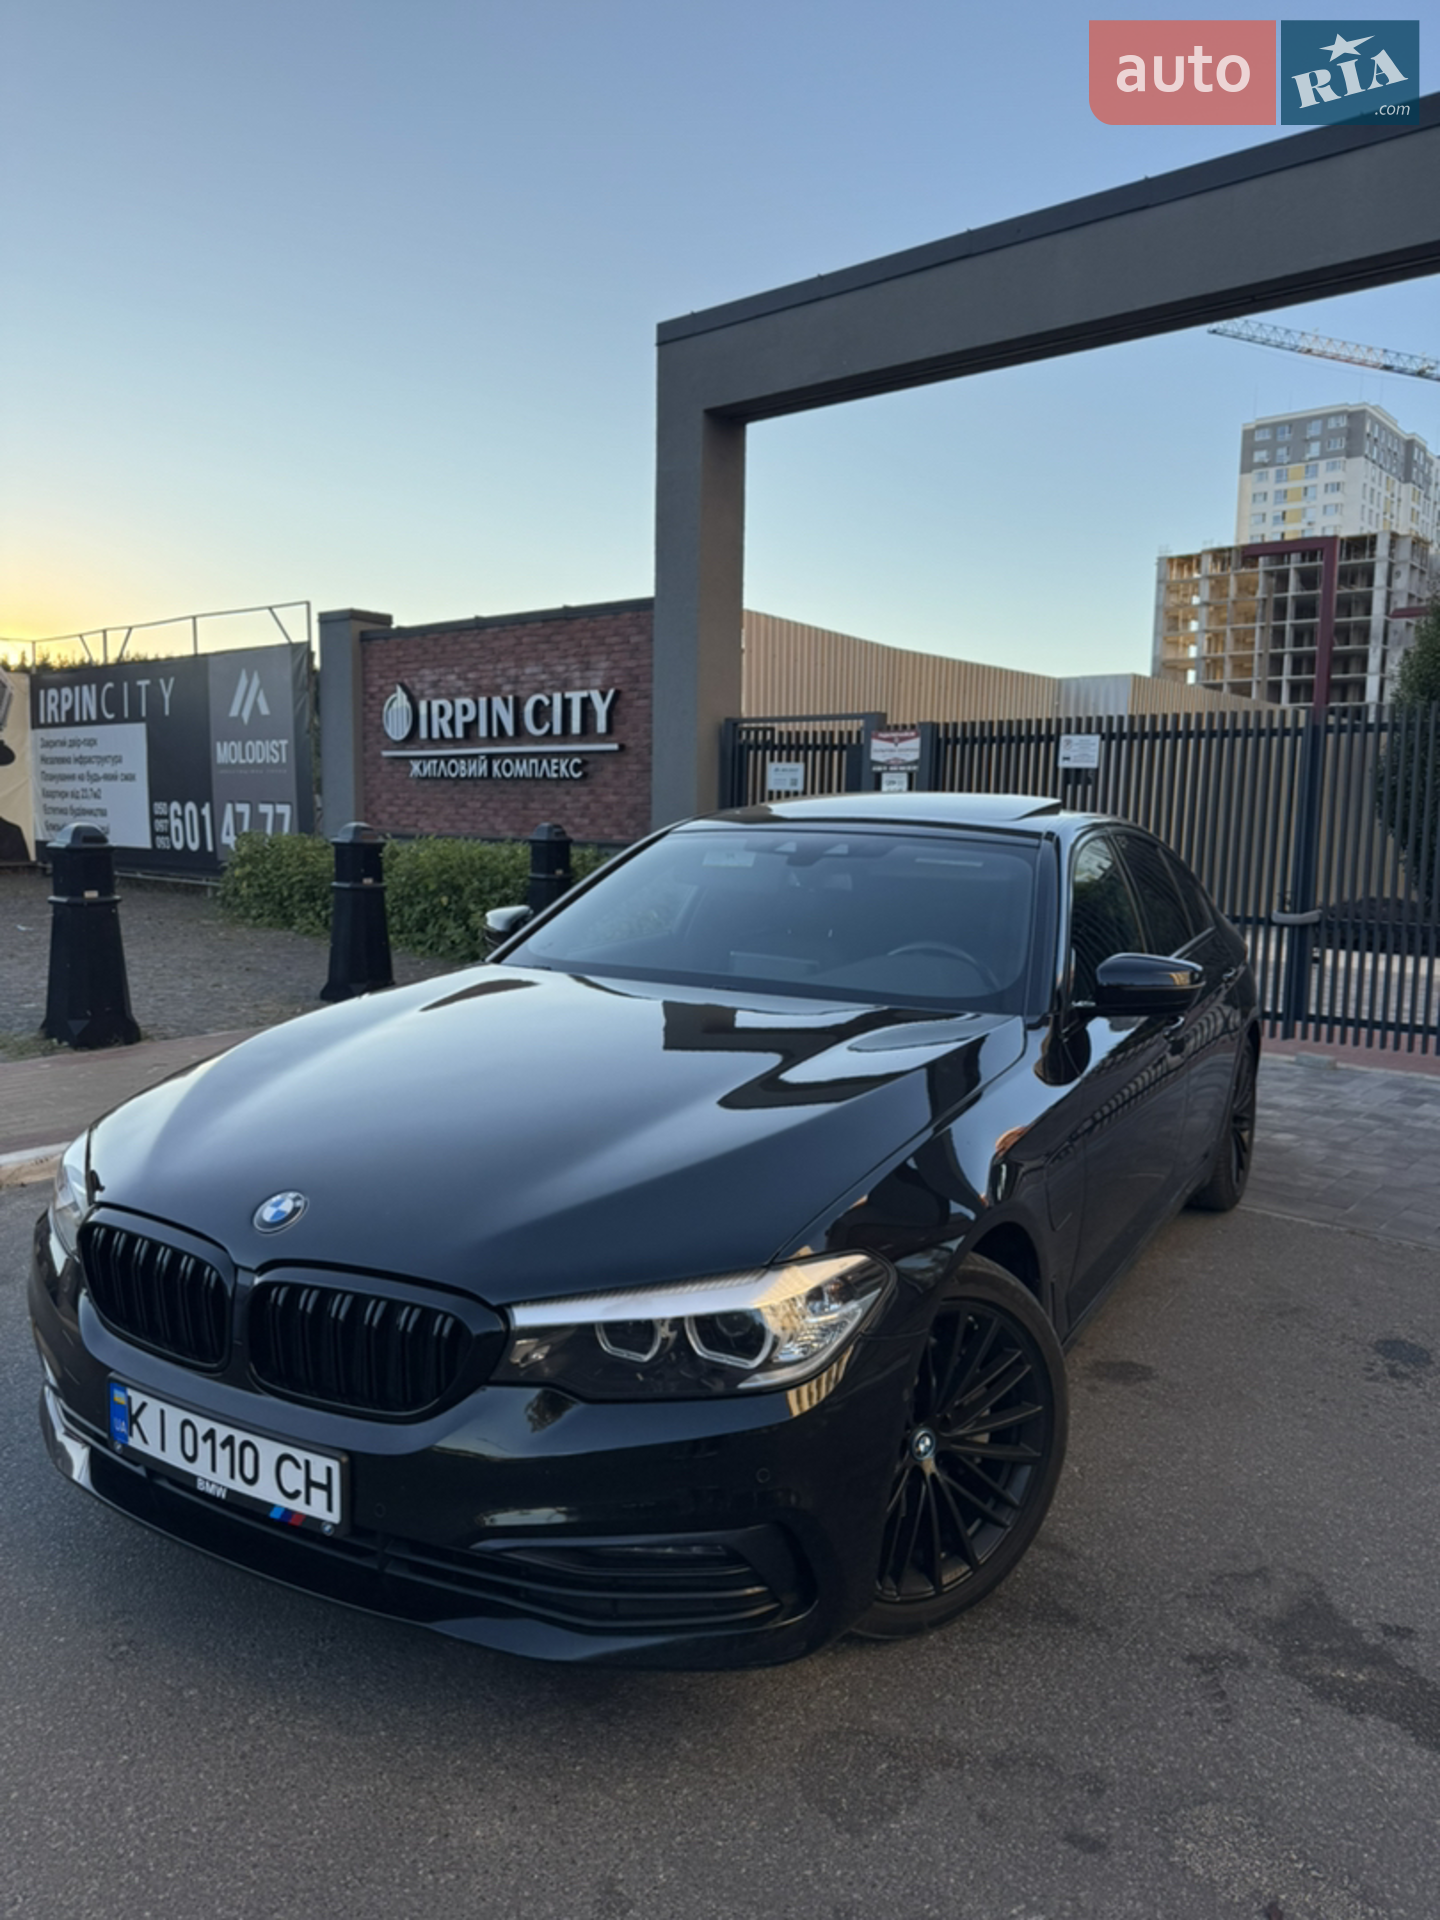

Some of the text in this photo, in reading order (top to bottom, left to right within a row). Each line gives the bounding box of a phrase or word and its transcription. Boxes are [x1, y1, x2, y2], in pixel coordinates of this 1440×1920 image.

[418, 688, 617, 740] IRPIN CITY
[216, 739, 288, 764] MOLODIST
[409, 756, 583, 778] ЖИТЛОВИЙ КОМПЛЕКС
[169, 800, 214, 852] 601
[179, 1418, 260, 1487] 0110
[275, 1452, 334, 1513] CH
[196, 1477, 227, 1500] BMW
